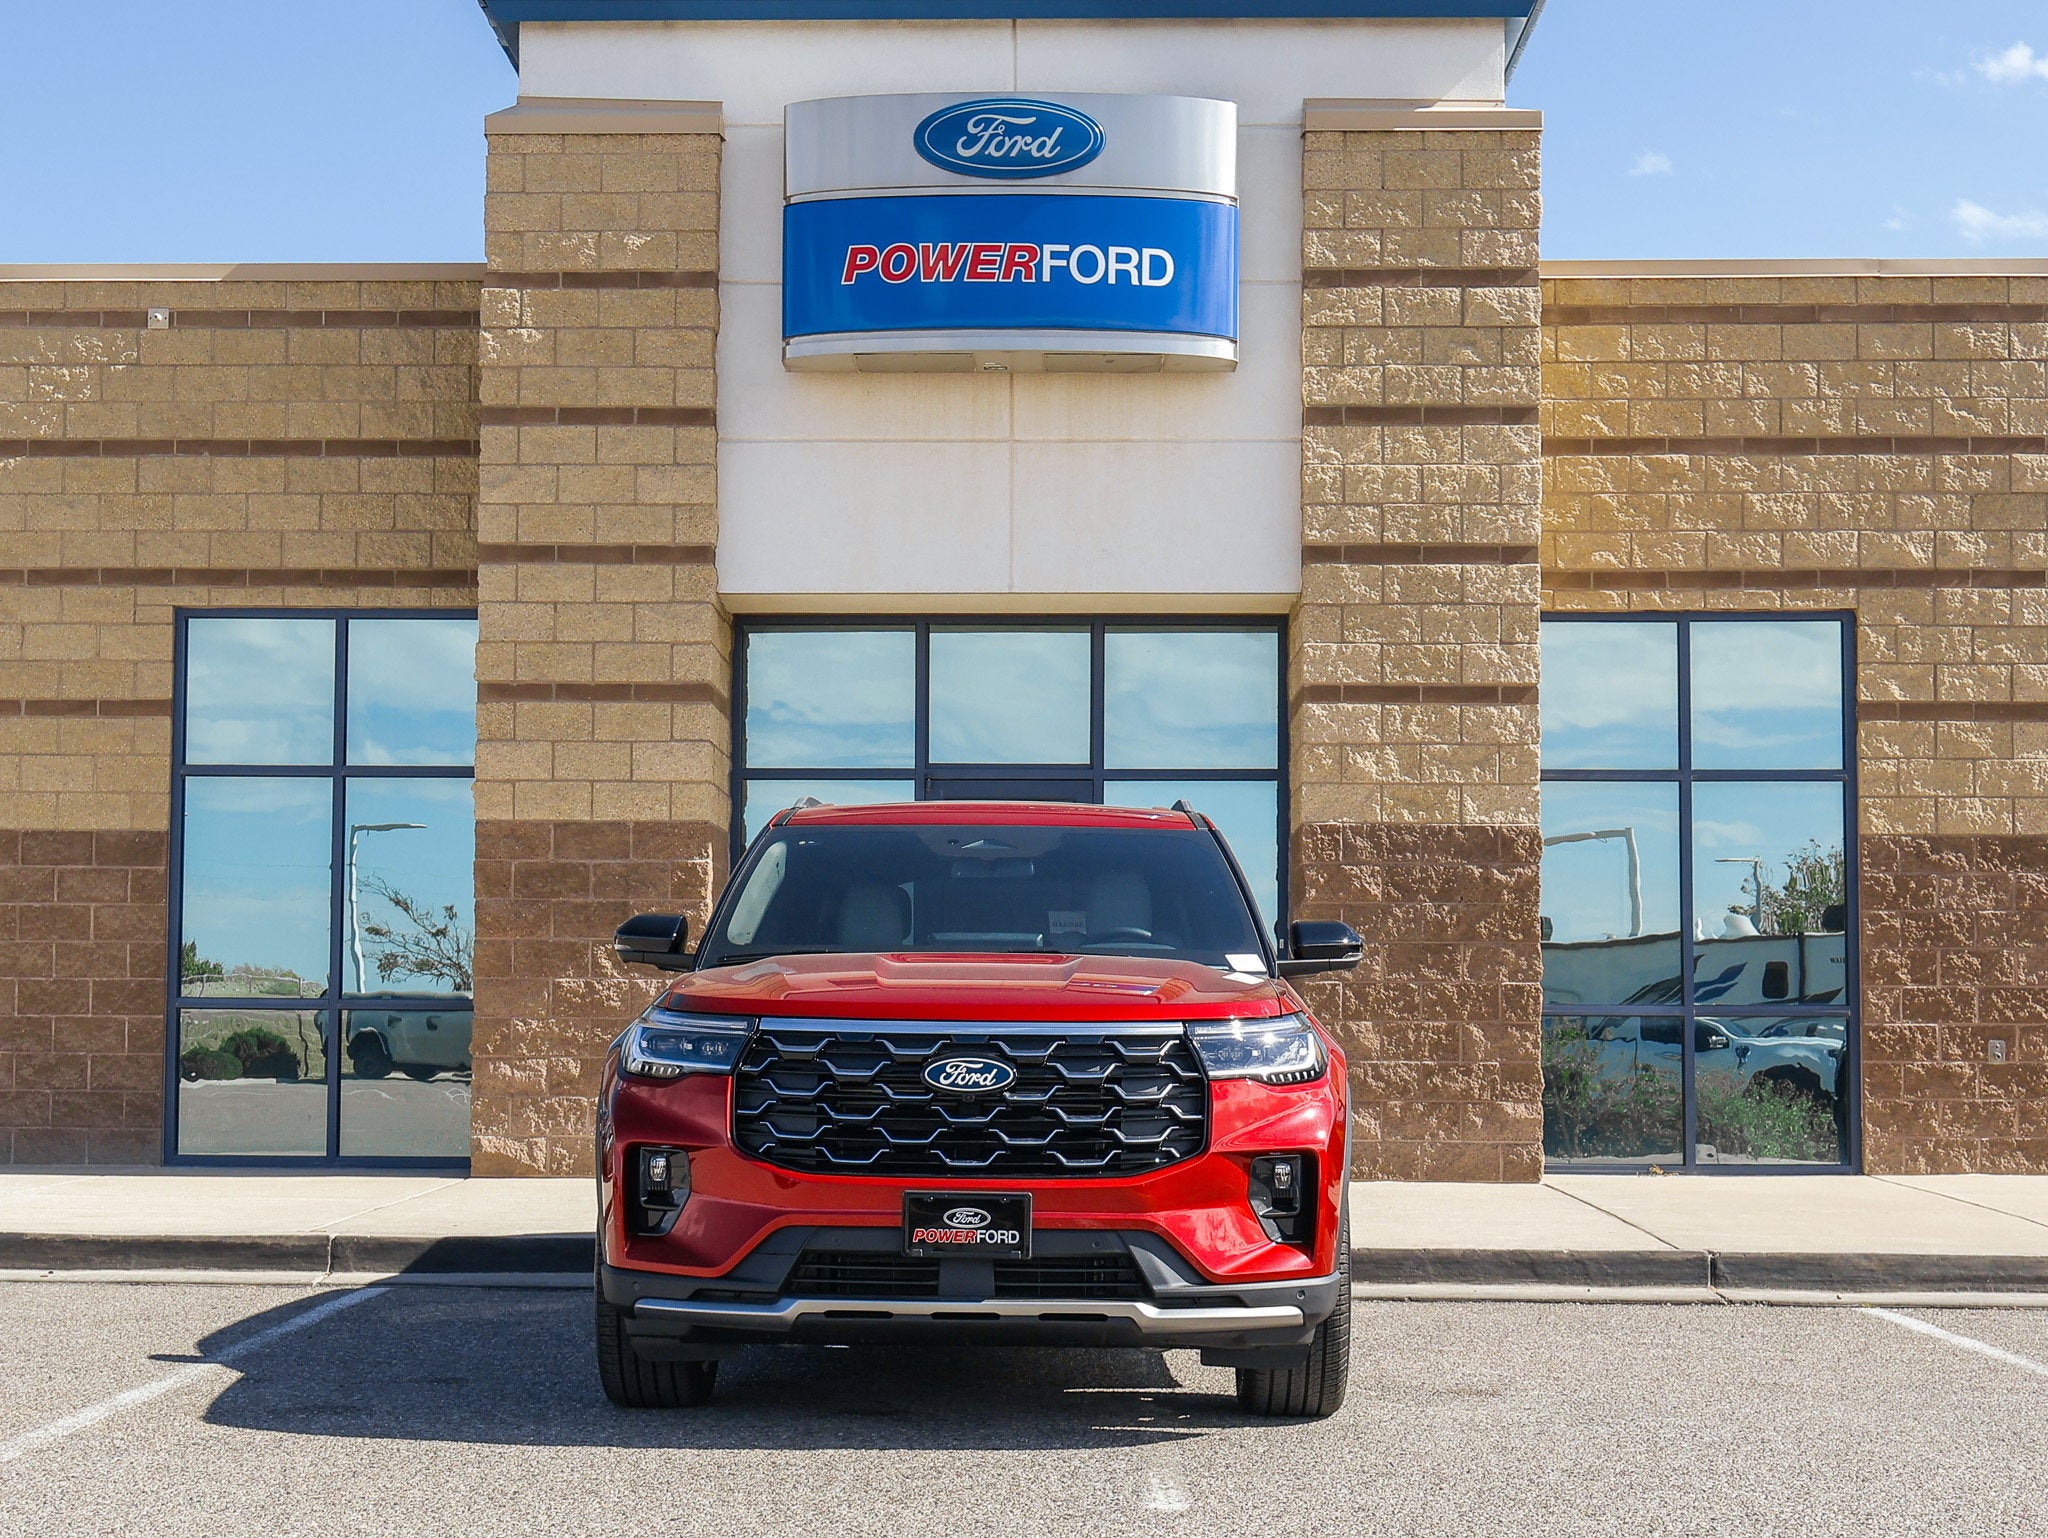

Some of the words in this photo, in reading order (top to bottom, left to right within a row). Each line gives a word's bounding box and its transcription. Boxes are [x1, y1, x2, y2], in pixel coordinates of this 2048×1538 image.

[956, 114, 1064, 159] Ford
[939, 1061, 998, 1086] Ford
[953, 1211, 981, 1224] Ford
